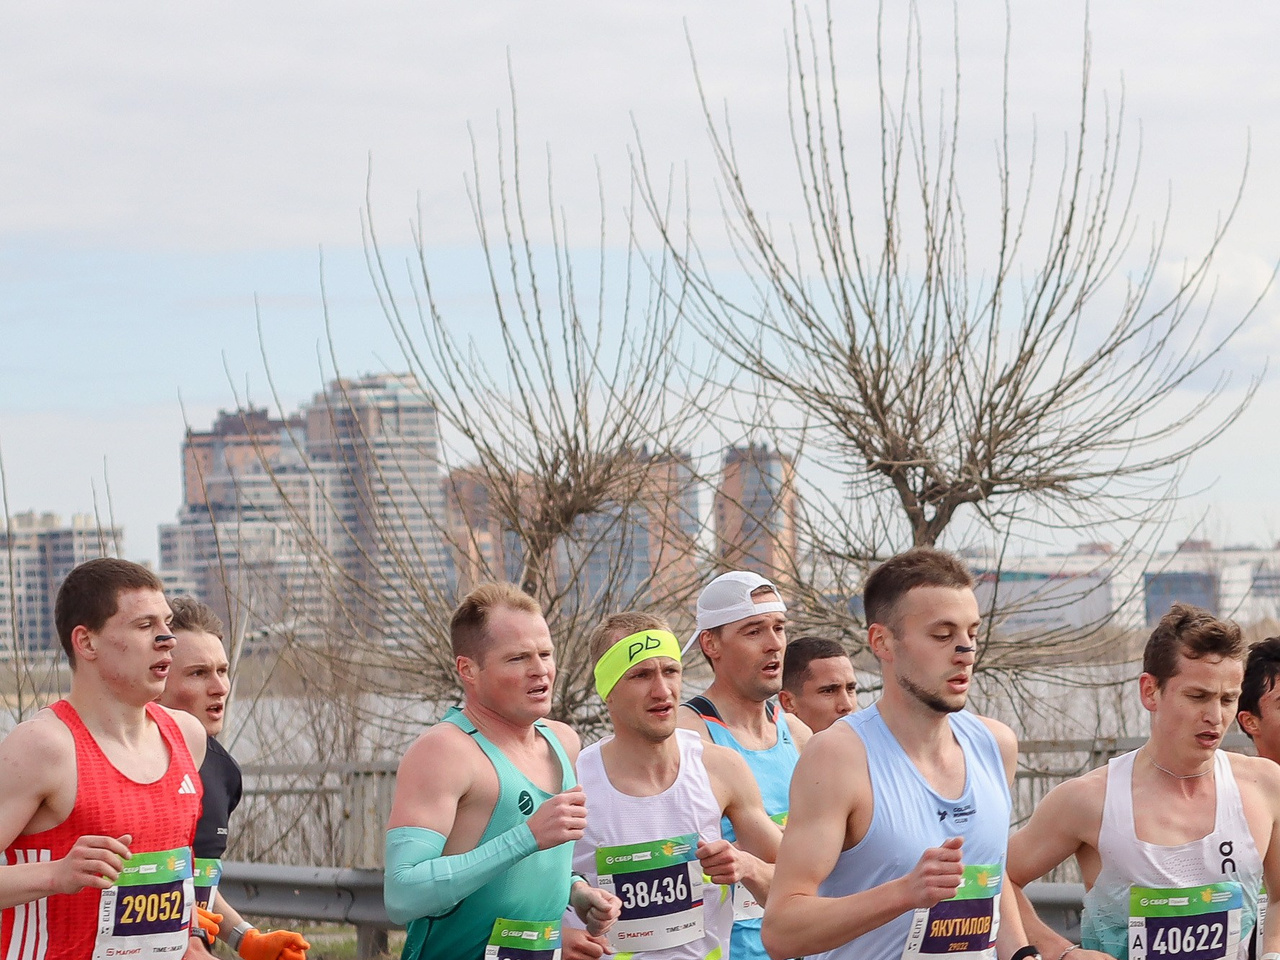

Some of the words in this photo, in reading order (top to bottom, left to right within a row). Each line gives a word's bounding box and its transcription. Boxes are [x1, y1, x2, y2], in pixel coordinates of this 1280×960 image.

[621, 873, 688, 910] 38436
[103, 900, 112, 923] ELITE
[120, 890, 182, 924] 29052
[626, 930, 654, 939] МАГНИТ
[929, 916, 991, 938] ЯКУТИЛОВ
[1152, 922, 1224, 955] 40622
